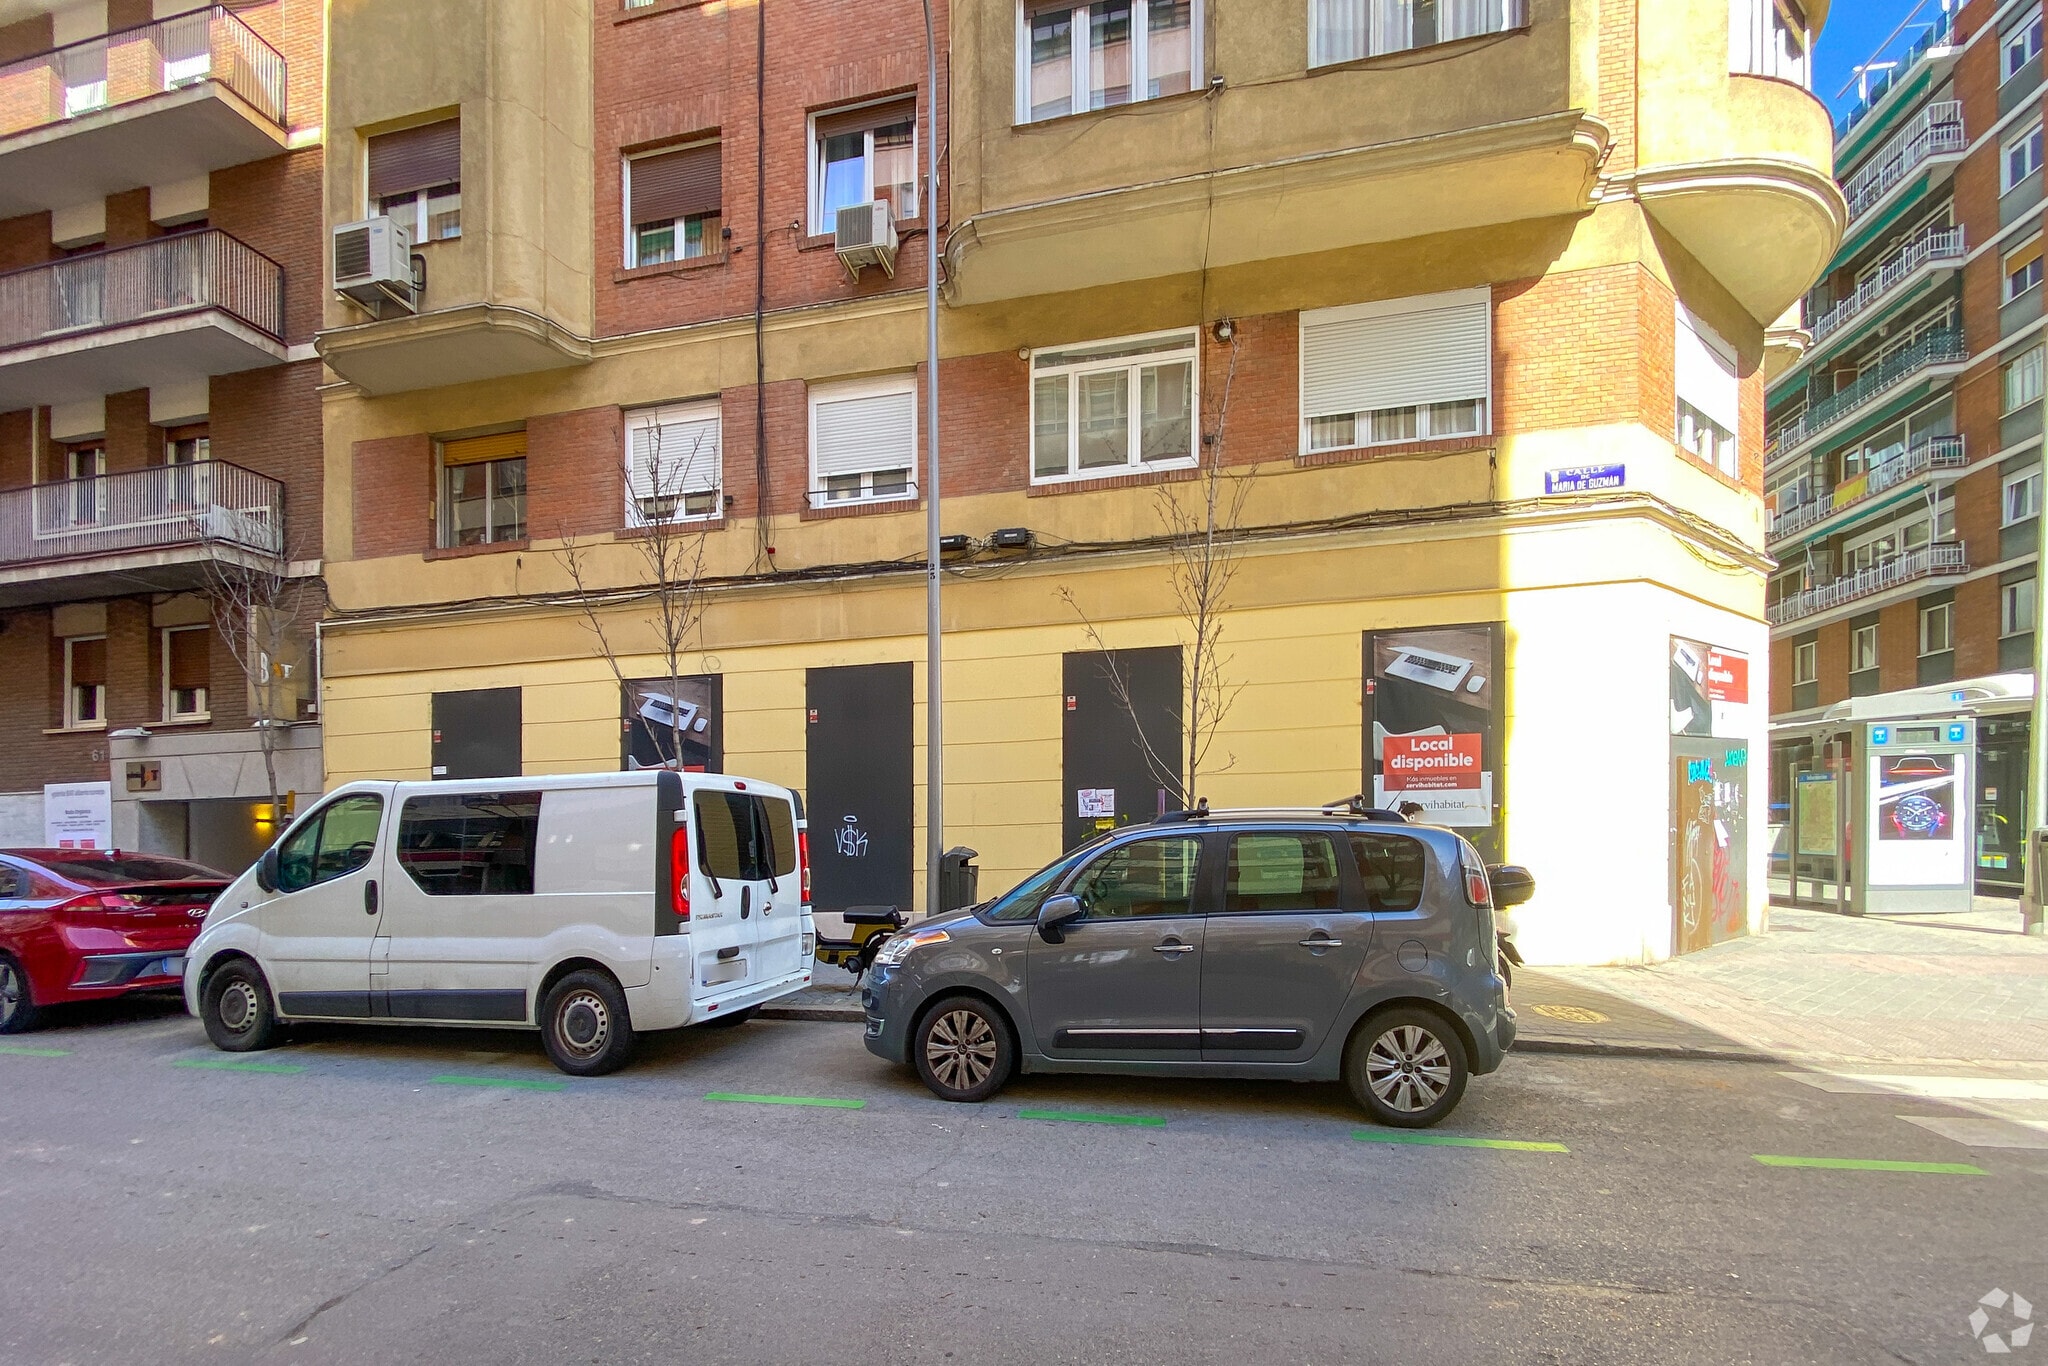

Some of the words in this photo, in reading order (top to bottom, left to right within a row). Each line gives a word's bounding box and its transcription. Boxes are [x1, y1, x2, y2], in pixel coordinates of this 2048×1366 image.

[1577, 479, 1588, 490] DE
[1410, 736, 1453, 752] Local
[91, 749, 105, 762] 61
[1390, 752, 1474, 772] disponible
[1421, 799, 1465, 810] rvihabitat
